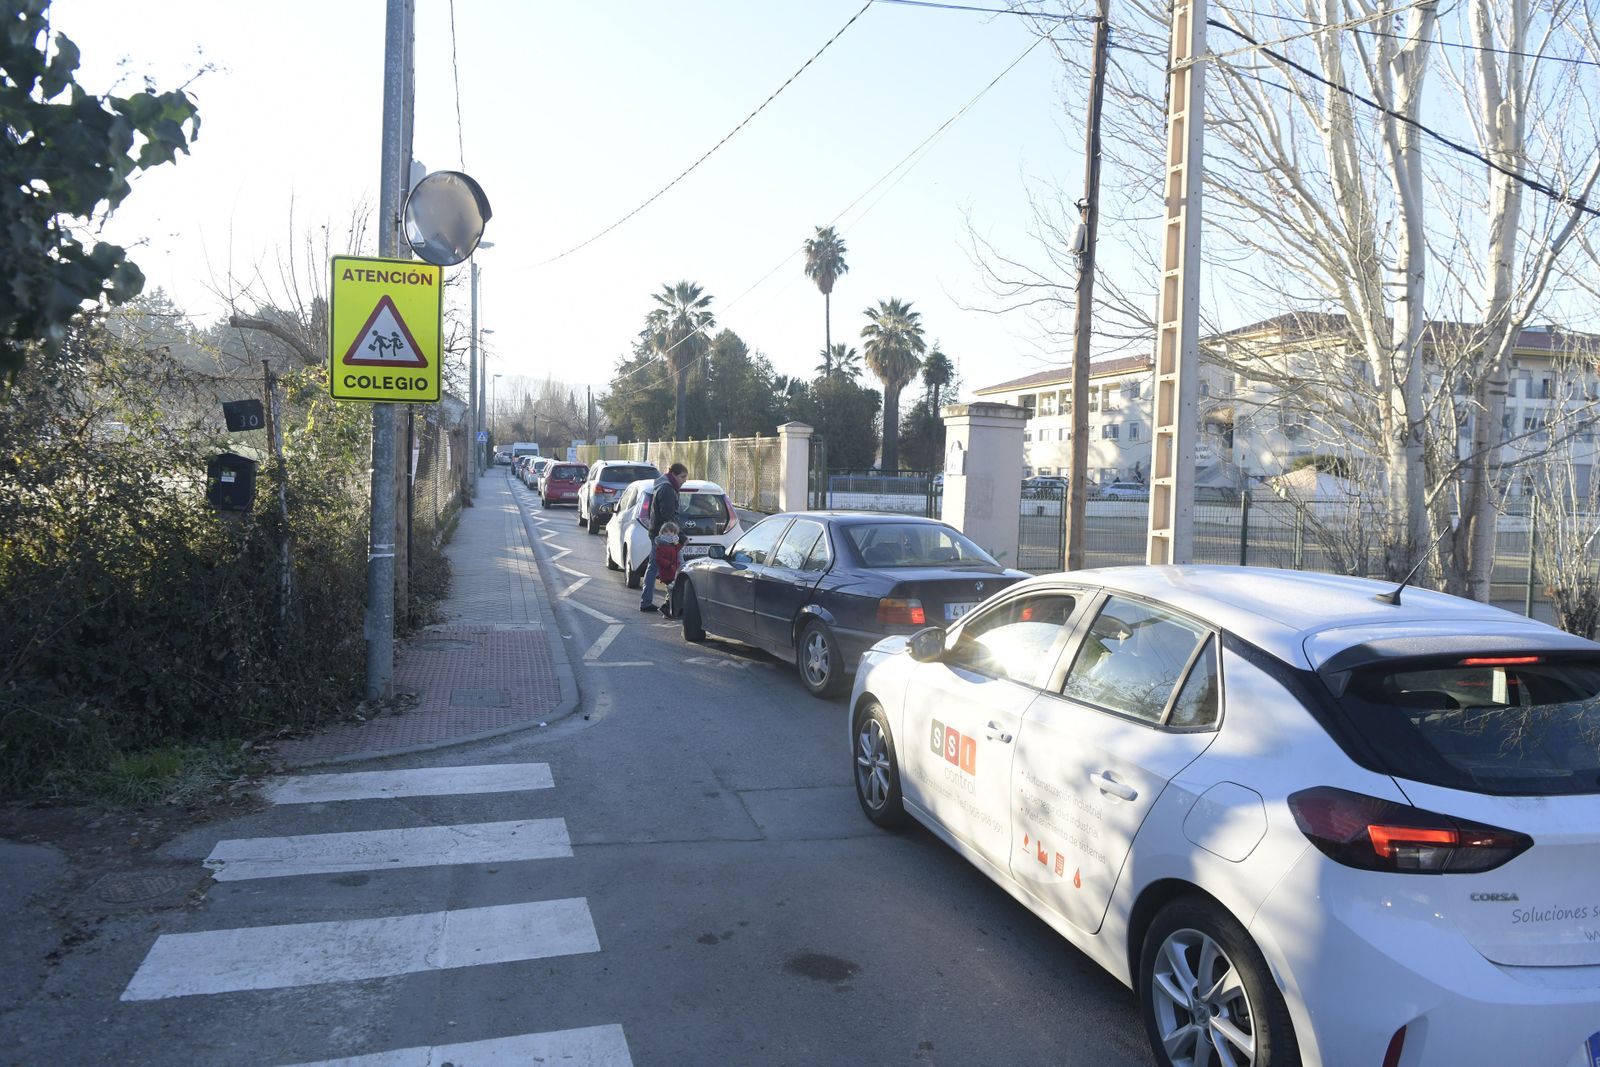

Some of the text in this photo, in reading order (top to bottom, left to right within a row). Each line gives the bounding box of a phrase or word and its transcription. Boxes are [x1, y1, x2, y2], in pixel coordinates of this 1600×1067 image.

[343, 268, 433, 286] ATENCIÓN
[344, 374, 429, 391] COLEGIO
[933, 727, 971, 767] SSI
[945, 767, 977, 797] control
[1470, 892, 1519, 902] CORSA
[1511, 904, 1588, 925] Soluciones
